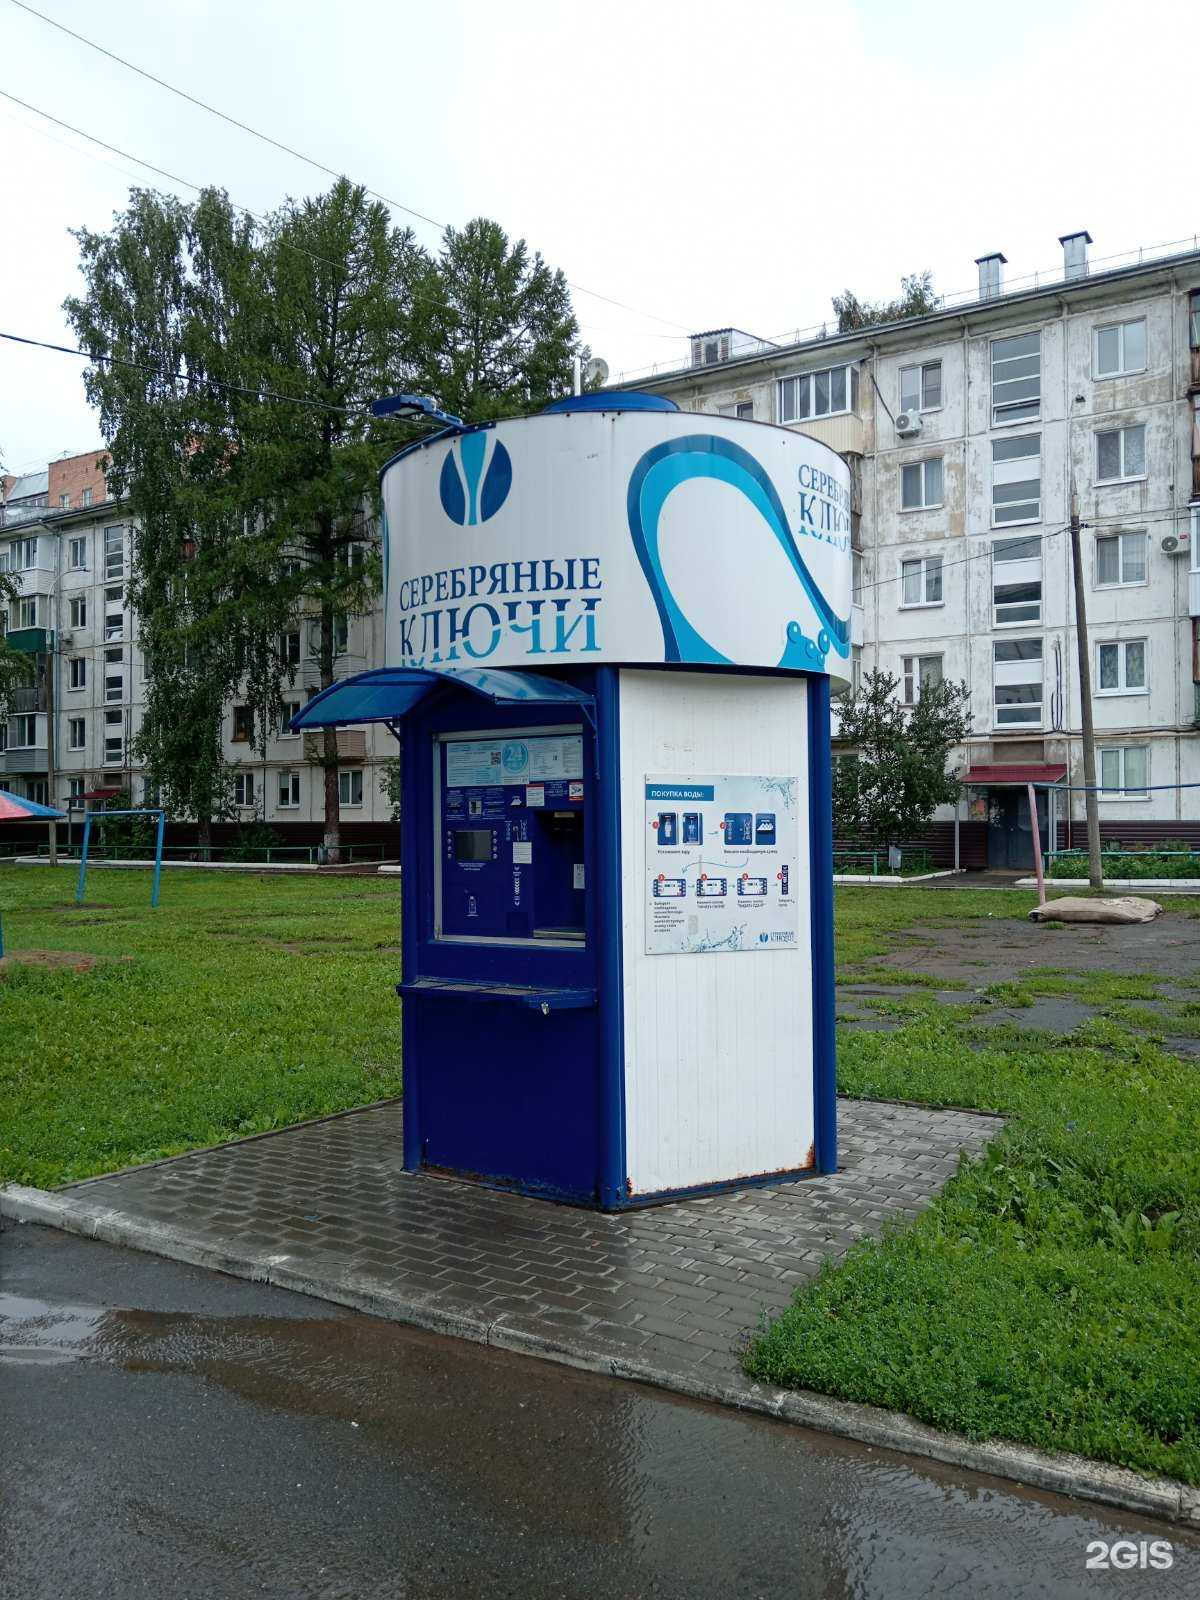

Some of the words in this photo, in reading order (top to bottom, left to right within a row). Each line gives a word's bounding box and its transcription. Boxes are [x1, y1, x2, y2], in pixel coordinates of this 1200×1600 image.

[400, 558, 602, 611] СЕРЕБРЯНЫЕ
[400, 598, 602, 667] КЛЮЧИ
[651, 790, 683, 798] ПОКУПКА
